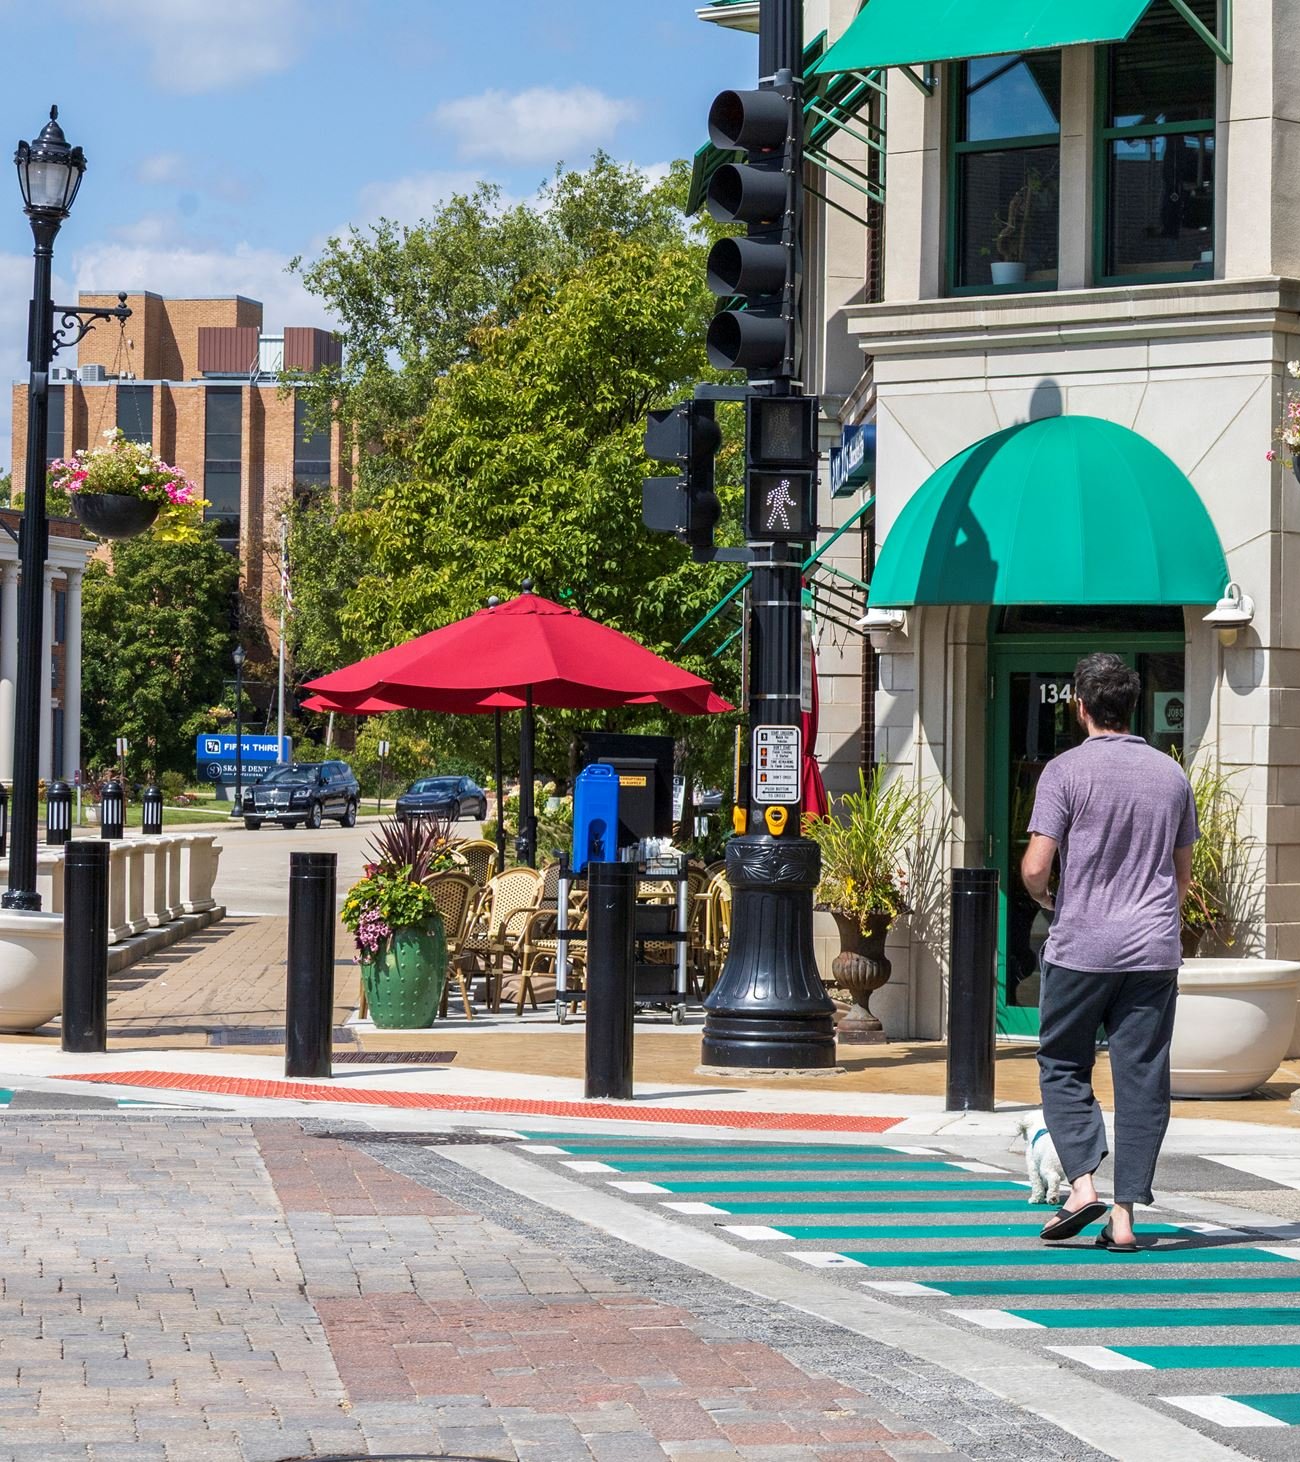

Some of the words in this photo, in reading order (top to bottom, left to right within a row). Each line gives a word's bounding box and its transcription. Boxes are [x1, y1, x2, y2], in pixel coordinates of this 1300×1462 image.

[1040, 683, 1077, 704] 134
[1166, 706, 1184, 718] JOBS
[252, 743, 279, 752] THIRD
